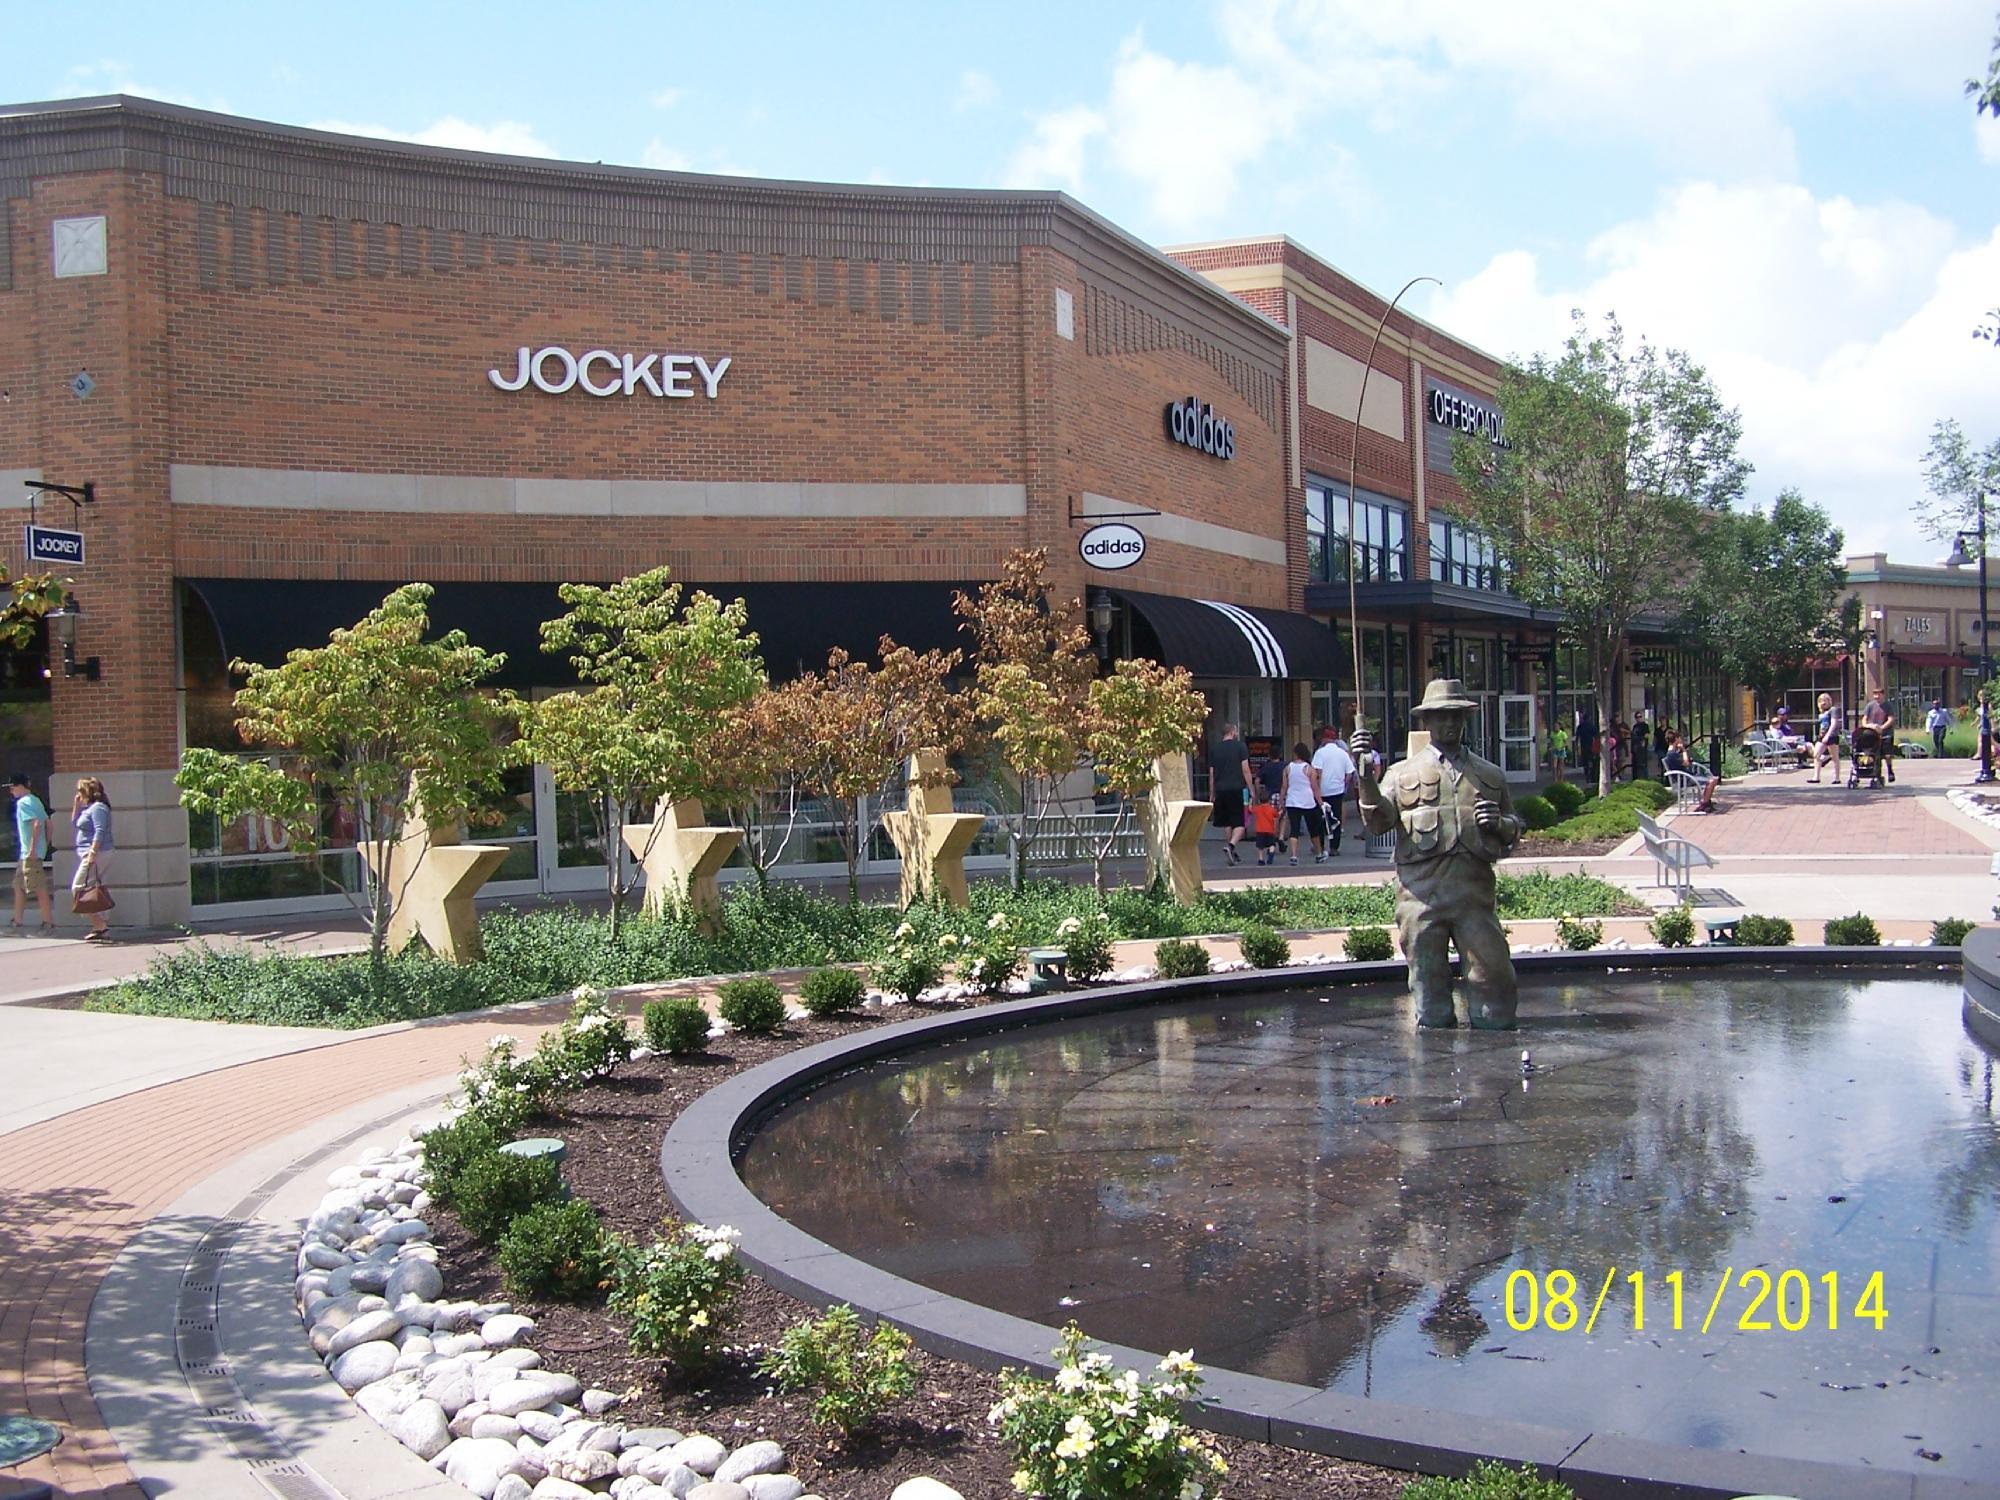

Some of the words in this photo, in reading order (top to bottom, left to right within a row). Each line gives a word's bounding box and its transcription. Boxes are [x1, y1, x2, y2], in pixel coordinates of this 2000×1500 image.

[488, 346, 732, 399] JOCKEY
[1170, 396, 1236, 460] adidas
[1434, 389, 1459, 428] OFF
[36, 537, 80, 555] JOCKEY
[1084, 539, 1142, 555] adidas
